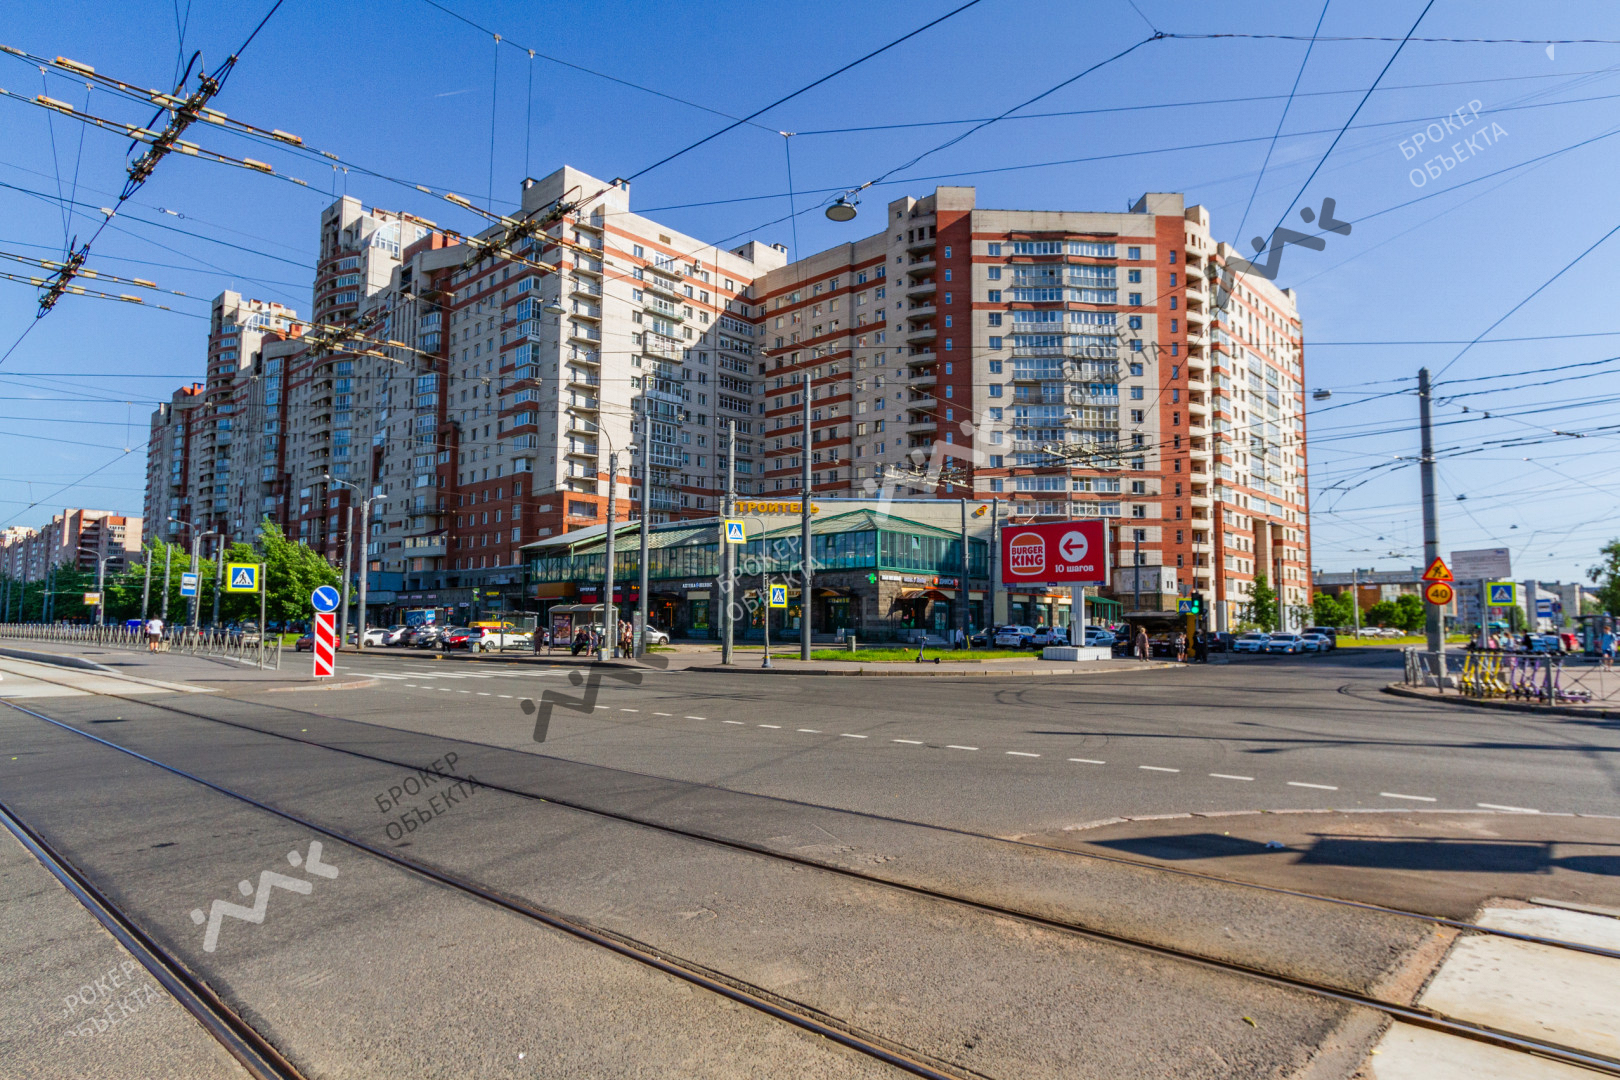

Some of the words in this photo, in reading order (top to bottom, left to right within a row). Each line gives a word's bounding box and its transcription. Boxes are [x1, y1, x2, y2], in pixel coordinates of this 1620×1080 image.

[734, 501, 820, 514] ТРОИТЕЬ
[1011, 546, 1043, 555] BURGER
[1011, 555, 1043, 566] KING
[1055, 564, 1064, 573] 10
[1066, 564, 1094, 573] шагов
[1430, 589, 1448, 599] 40
